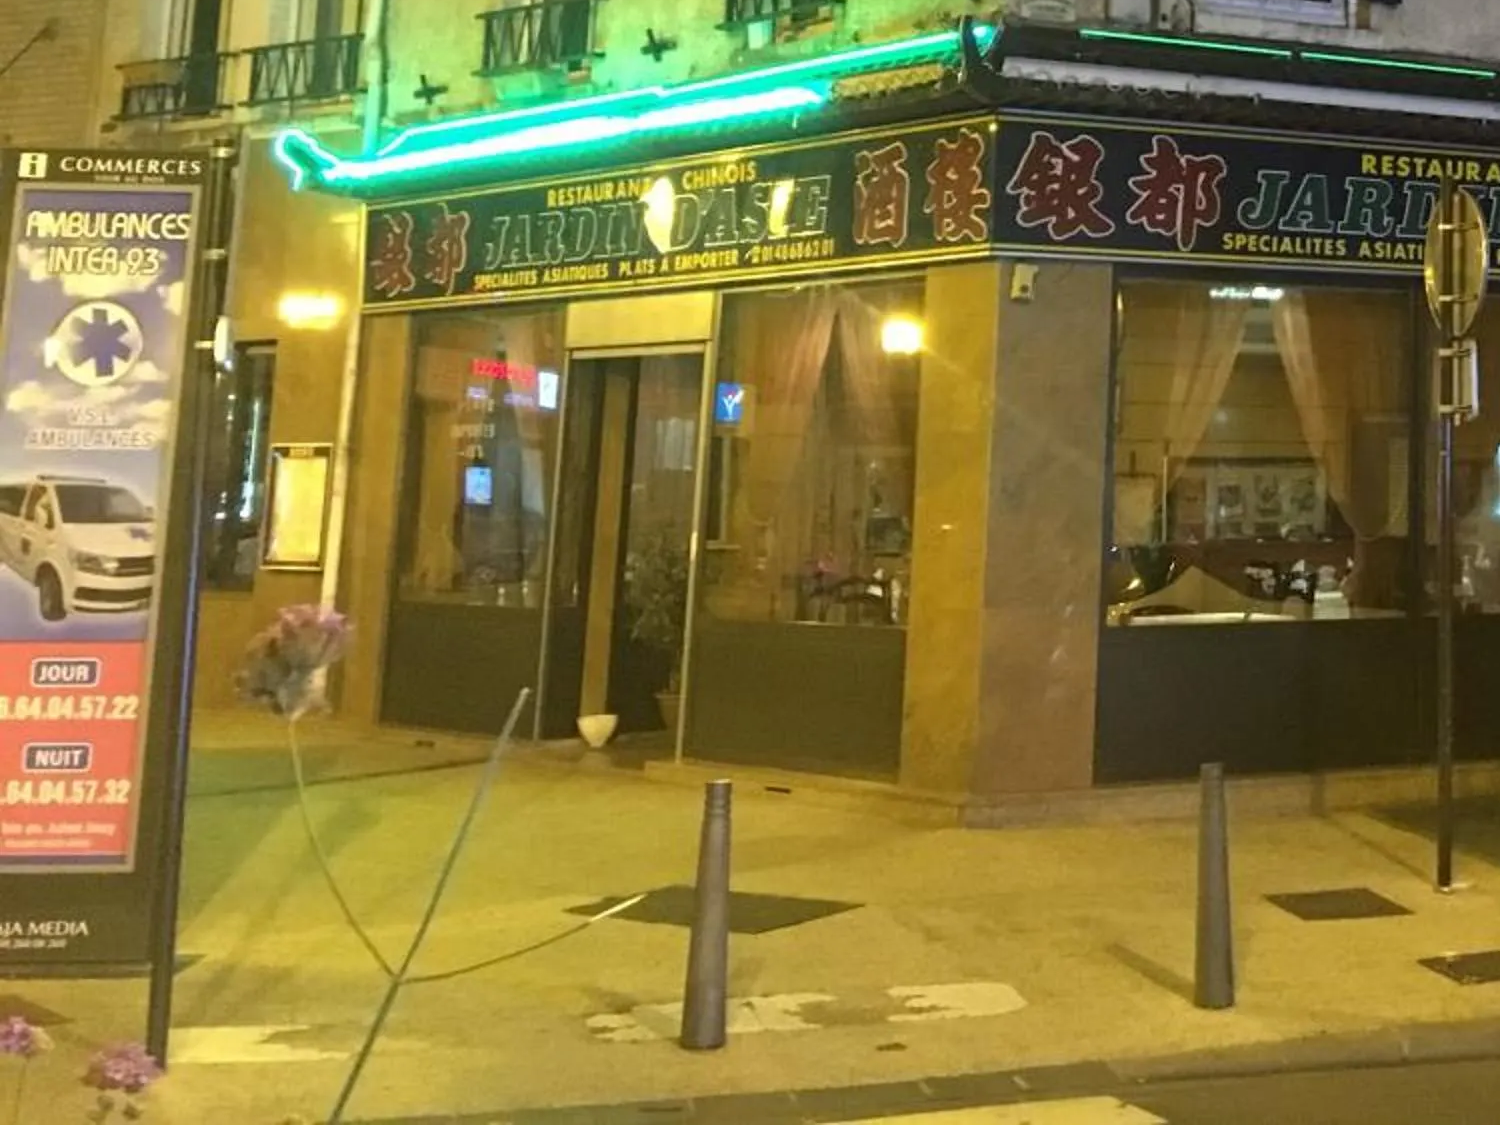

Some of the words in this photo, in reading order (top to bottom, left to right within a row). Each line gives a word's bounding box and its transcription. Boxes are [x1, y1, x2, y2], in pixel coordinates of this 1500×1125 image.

[60, 156, 202, 174] COMMERCES
[682, 160, 757, 191] CHINOIS
[25, 210, 193, 241] AMBULANCES
[483, 200, 650, 271] JARDIN
[1221, 231, 1347, 256] SPECIALITES
[126, 247, 161, 275] 93
[473, 269, 537, 293] SPECIALITES
[543, 262, 609, 285] ASIATIQUES
[618, 258, 656, 277] PLATS
[660, 257, 669, 272] A
[674, 248, 739, 271] EMPORTER
[39, 664, 90, 682] JOUR
[34, 749, 84, 767] NUIT
[28, 920, 89, 936] MEDIA
